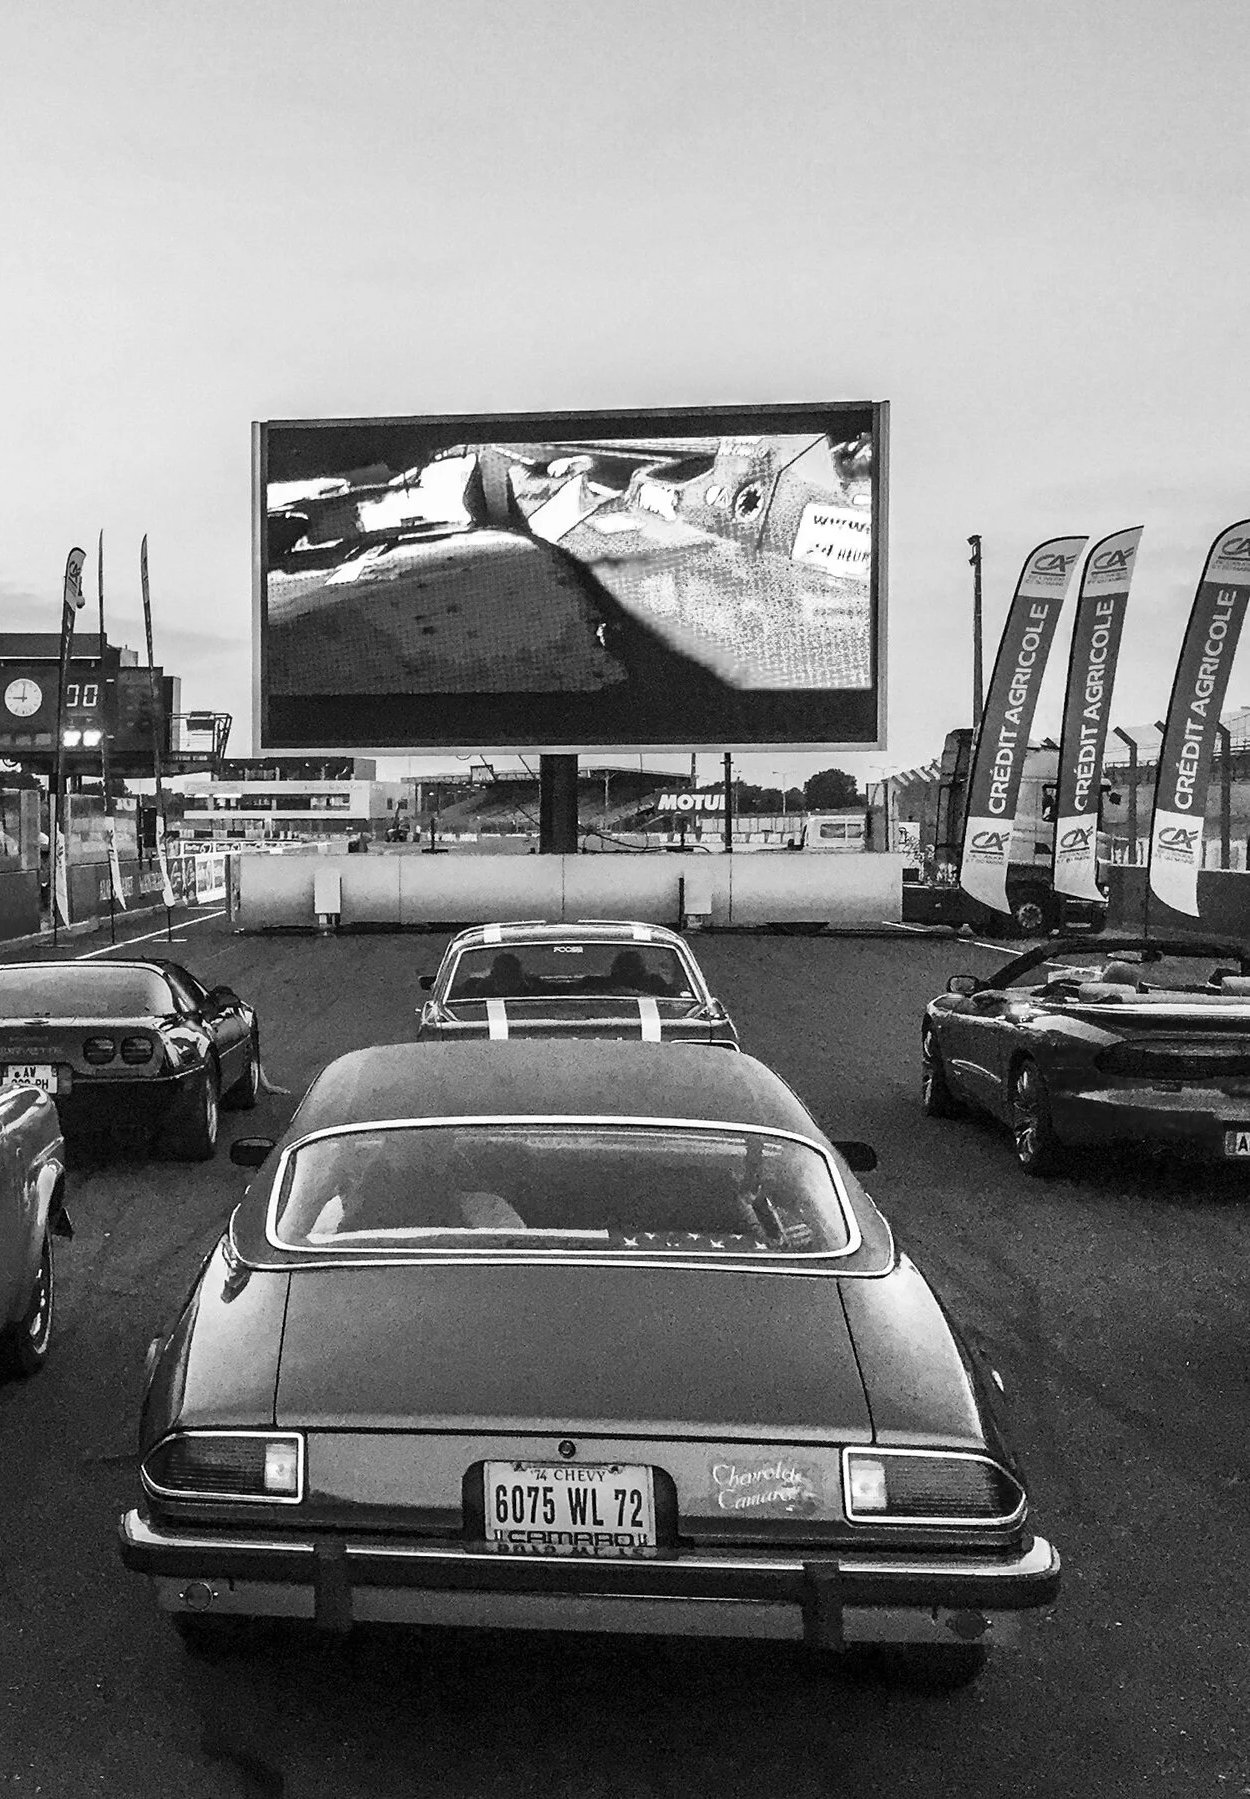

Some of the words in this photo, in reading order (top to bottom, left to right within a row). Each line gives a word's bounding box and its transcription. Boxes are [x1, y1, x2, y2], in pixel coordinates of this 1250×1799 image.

[1083, 599, 1114, 720] AGRICOLE
[989, 726, 1017, 814] CRÉDIT
[1003, 603, 1049, 724] AGRICOLE
[1174, 718, 1205, 810] CRÉDIT
[1191, 589, 1237, 717] AGRICOLE
[1074, 725, 1098, 811] CRÉDIT
[1238, 1134, 1249, 1151] A
[495, 1484, 556, 1525] 6075
[567, 1487, 604, 1526] WL
[614, 1489, 644, 1528] 72
[554, 1469, 607, 1483] CHEVY
[507, 1530, 634, 1547] CAMARO
